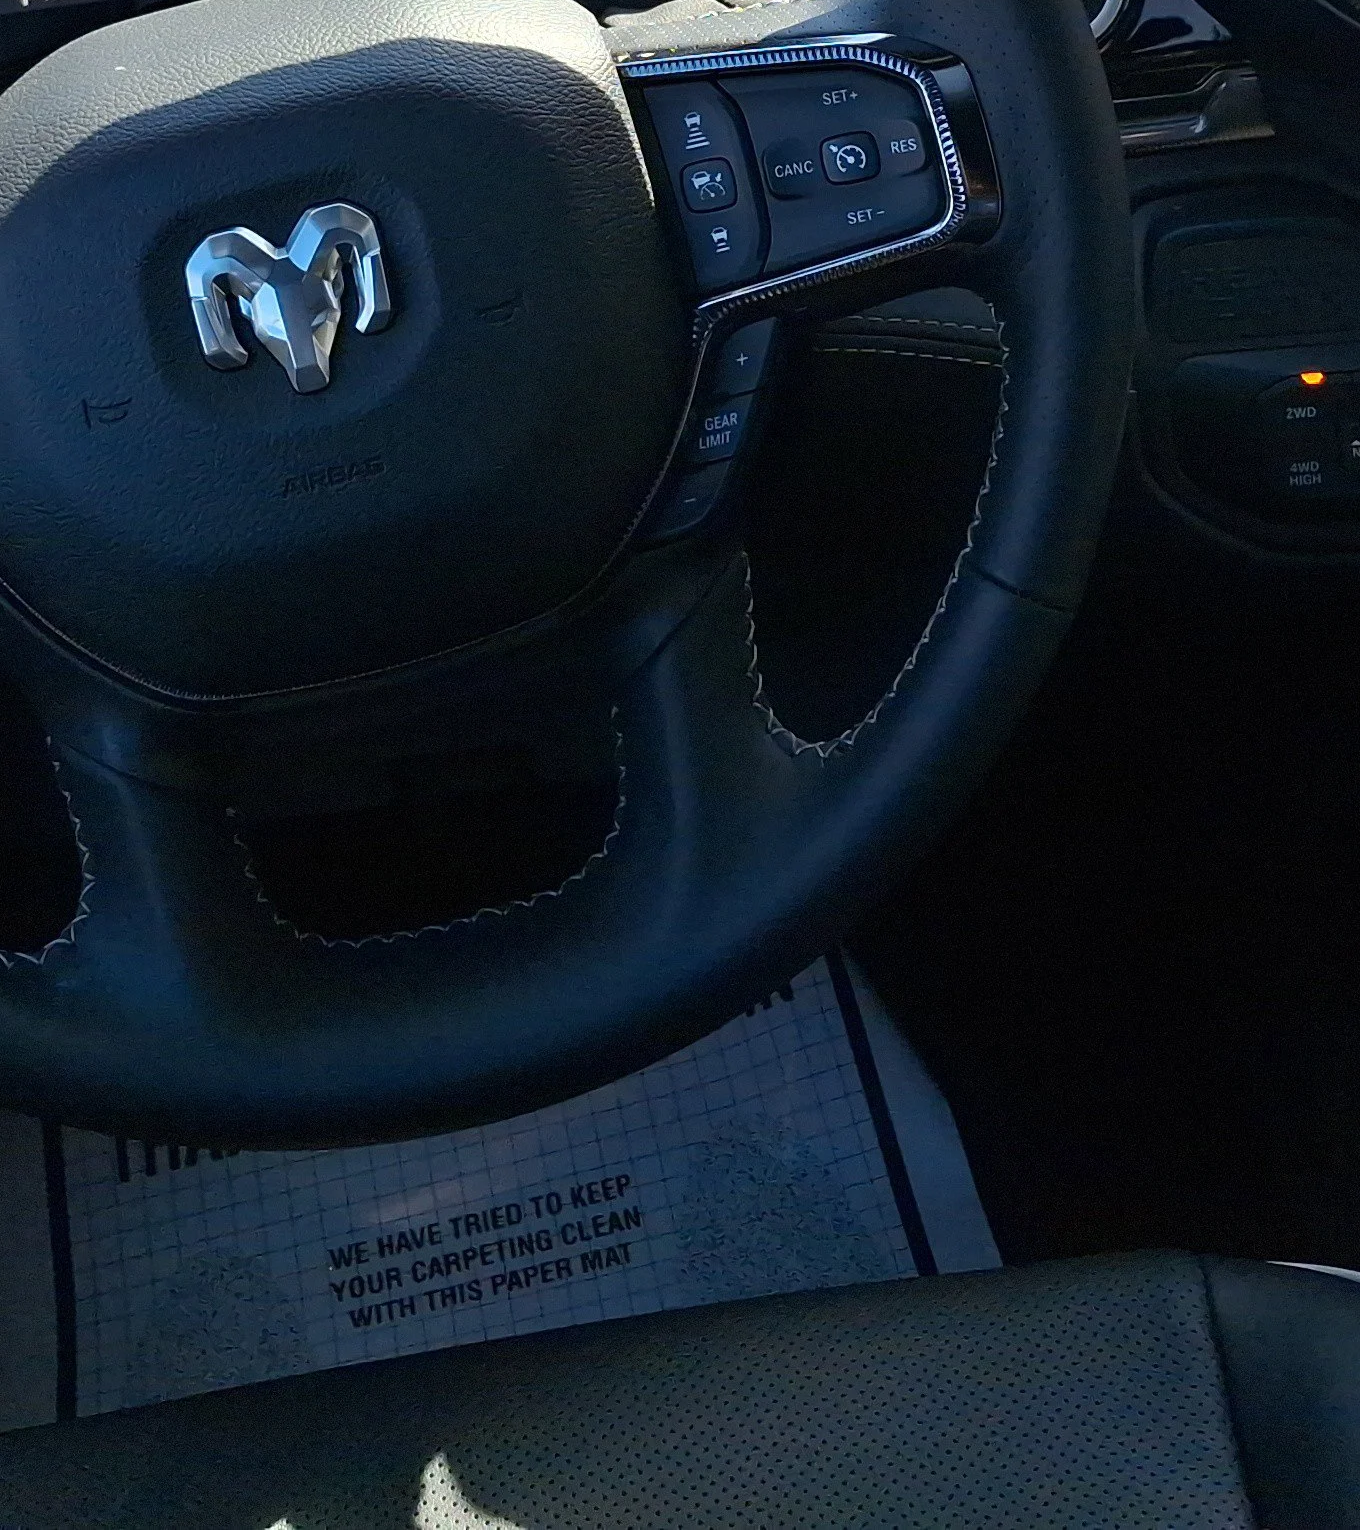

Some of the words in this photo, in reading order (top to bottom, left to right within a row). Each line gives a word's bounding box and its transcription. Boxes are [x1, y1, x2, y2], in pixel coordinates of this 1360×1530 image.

[890, 138, 918, 154] RES
[774, 160, 814, 178] CANC
[704, 412, 738, 432] GEAR
[1286, 407, 1317, 420] 2WD
[698, 431, 732, 450] LIMIT
[1353, 447, 1360, 457] N
[1290, 461, 1320, 473] 4WD
[1290, 473, 1321, 486] HIGH
[330, 1242, 370, 1270] WE
[377, 1222, 442, 1258] HAVE
[448, 1203, 521, 1239] TRIED
[529, 1192, 562, 1219] TO
[570, 1174, 631, 1209] KEEP
[330, 1267, 402, 1302] YOUR
[411, 1229, 553, 1283] CARPETING
[561, 1205, 642, 1245] CLEAN
[348, 1296, 416, 1328] WITH
[424, 1279, 482, 1310] THIS
[491, 1257, 572, 1294] PAPER
[580, 1242, 631, 1274] MAT
